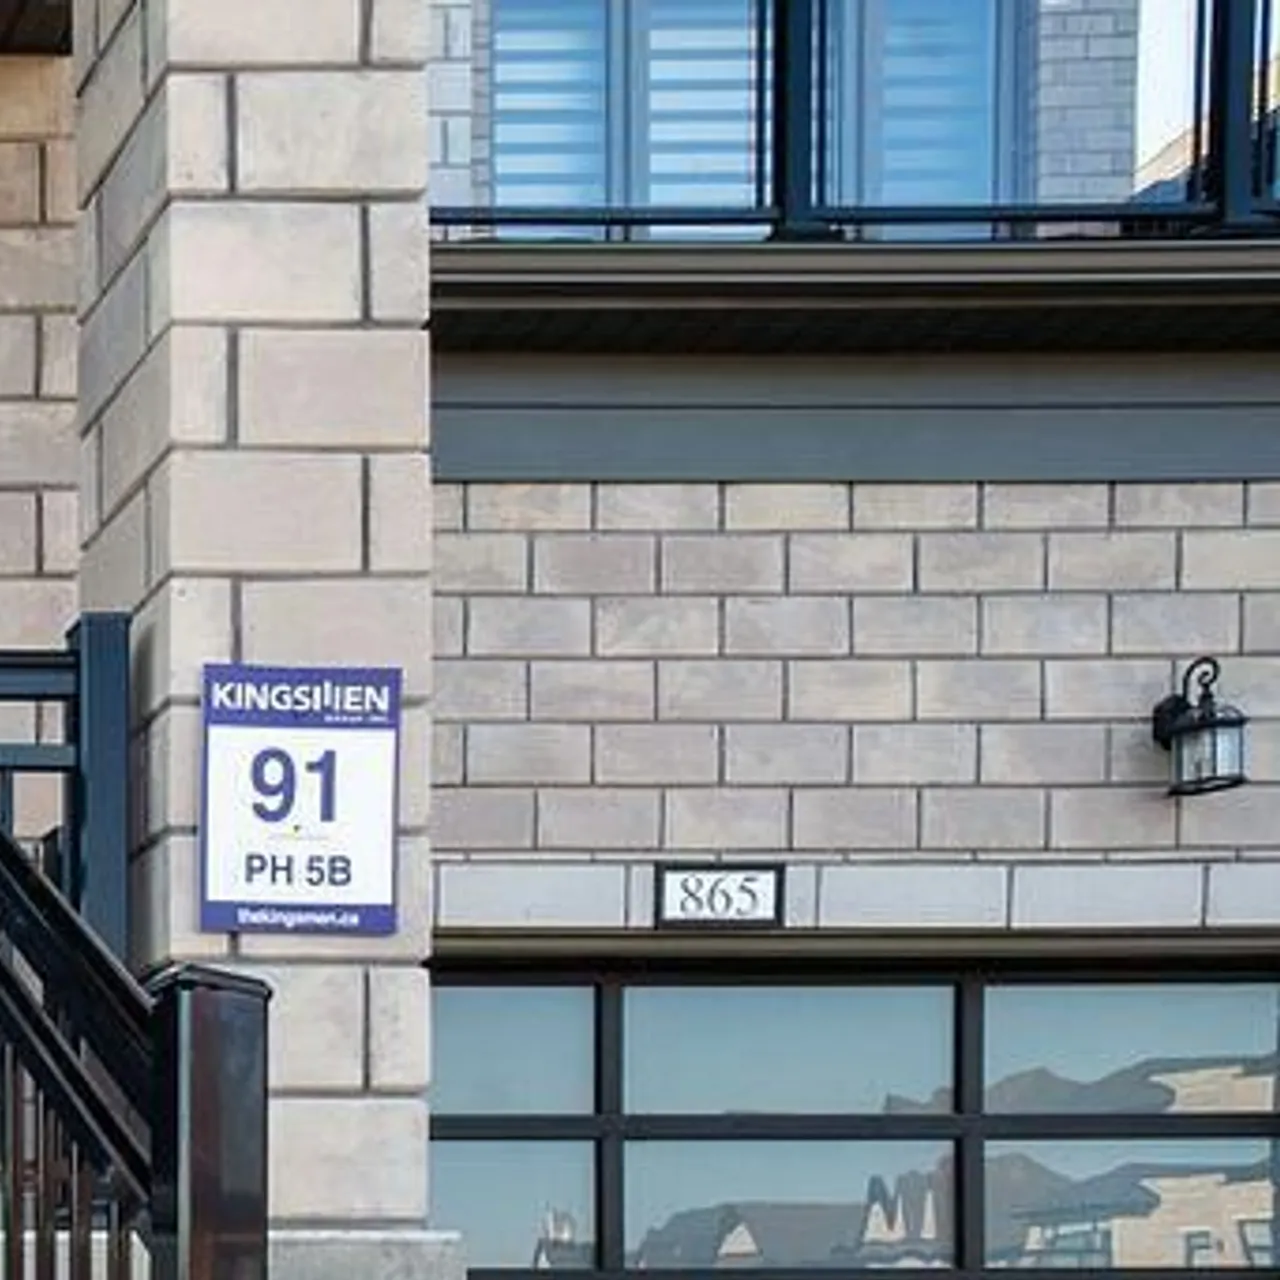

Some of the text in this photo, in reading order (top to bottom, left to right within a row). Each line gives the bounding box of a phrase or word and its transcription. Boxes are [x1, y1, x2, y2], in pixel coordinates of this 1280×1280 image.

[250, 747, 337, 823] 91
[245, 854, 352, 886] PH 5B
[679, 874, 759, 916] 865
